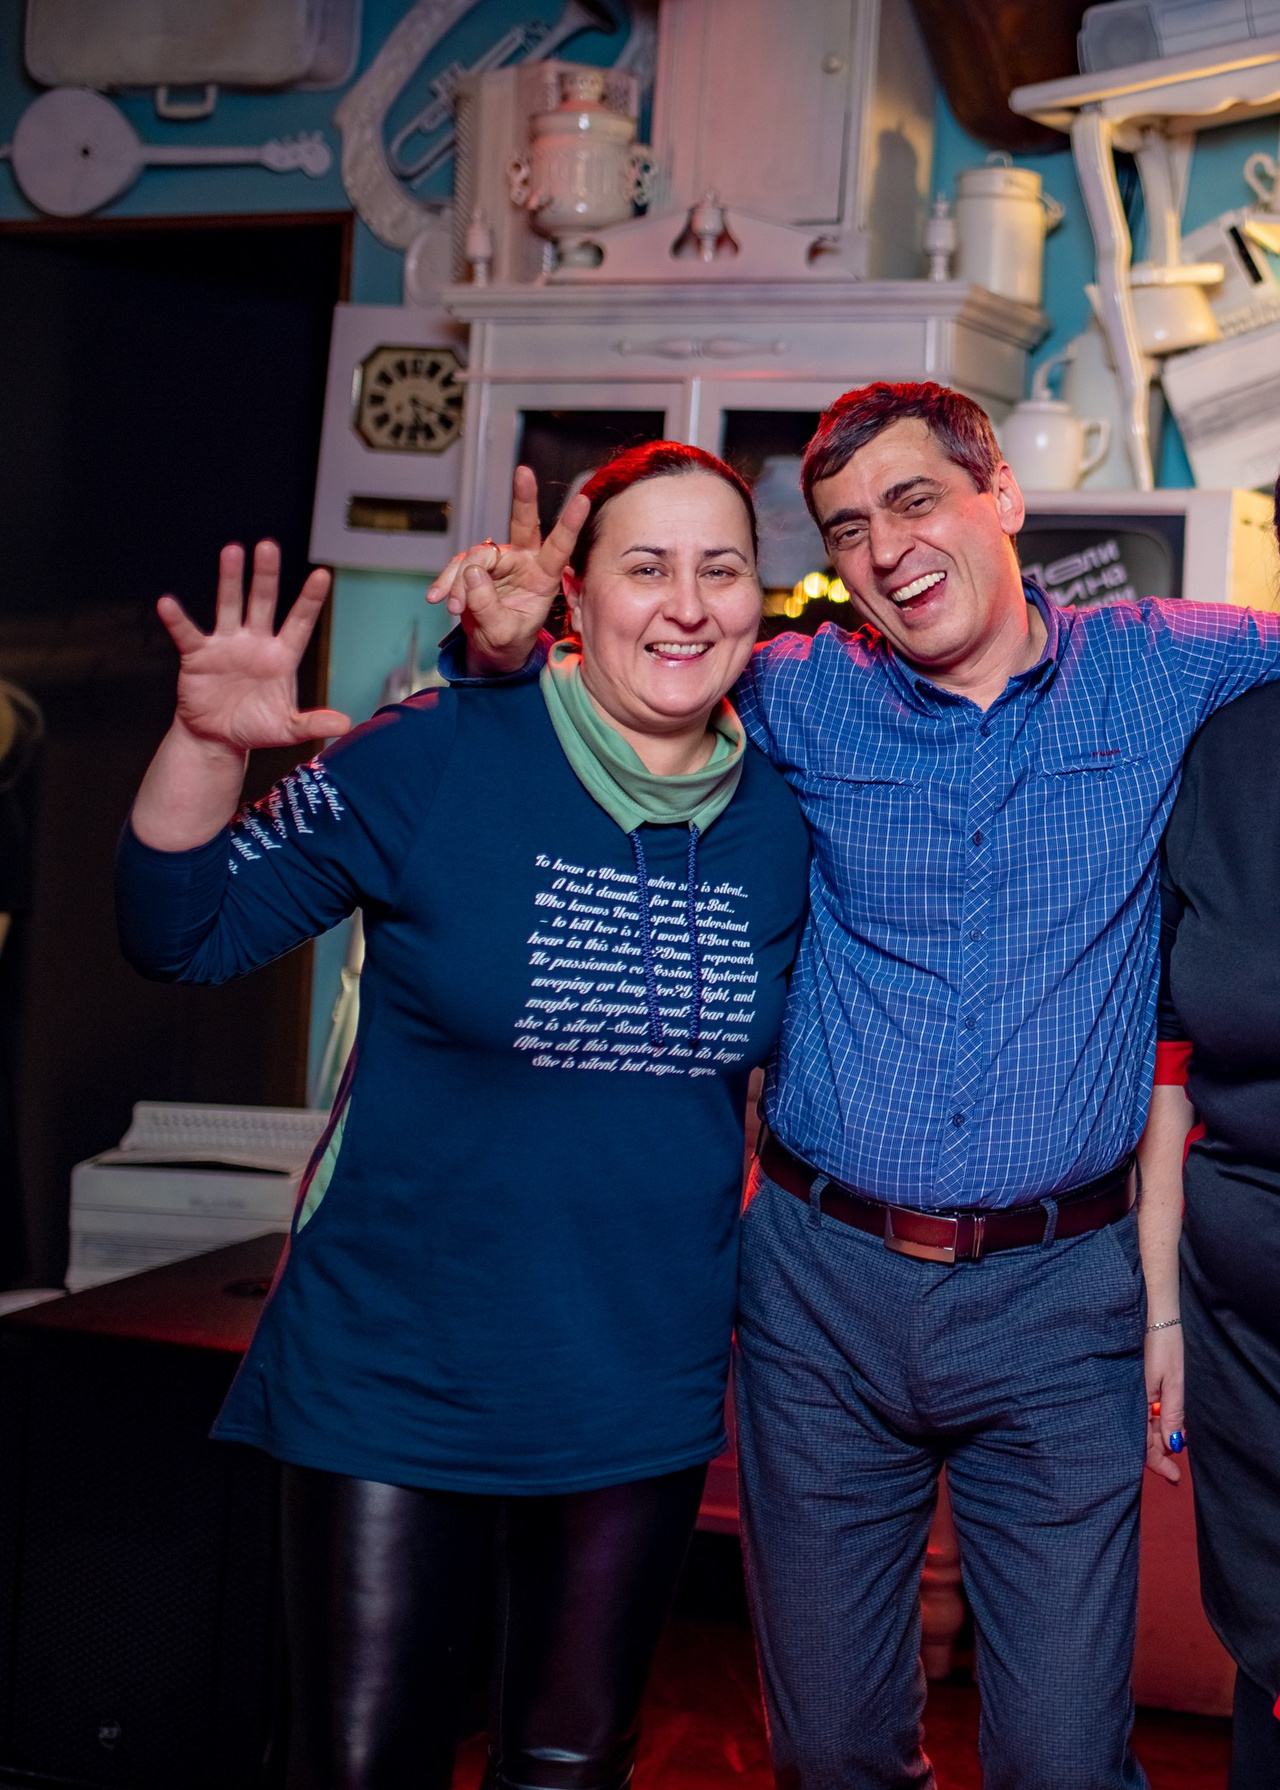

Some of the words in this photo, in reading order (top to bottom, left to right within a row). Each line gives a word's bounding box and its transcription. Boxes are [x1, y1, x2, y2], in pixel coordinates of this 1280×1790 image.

[535, 853, 550, 868] To
[552, 858, 585, 875] hear
[587, 869, 598, 878] a
[598, 867, 639, 885] Woma
[647, 876, 676, 891] when
[700, 881, 711, 893] is
[713, 882, 749, 899] silent...
[551, 877, 567, 890] A
[565, 880, 595, 896] task
[648, 894, 670, 908] for
[534, 892, 566, 909] Who
[567, 898, 610, 916] knows
[694, 915, 750, 933] nderstand
[551, 916, 567, 928] to
[568, 917, 595, 931] kill
[593, 920, 618, 935] her
[620, 925, 632, 937] is
[732, 939, 751, 948] can
[526, 930, 565, 947] hear
[566, 936, 583, 949] in
[584, 938, 609, 952] this
[702, 952, 754, 967] reproach
[547, 957, 628, 973] passionate
[530, 976, 596, 995] weeping
[596, 982, 616, 993] or
[733, 989, 757, 1003] and
[524, 996, 580, 1014] maybe
[726, 1008, 757, 1023] what
[514, 1015, 544, 1030] she
[544, 1017, 560, 1031] is
[562, 1018, 607, 1033] silent
[698, 1029, 724, 1041] not
[512, 1034, 554, 1051] After
[554, 1038, 582, 1053] all,
[582, 1038, 609, 1052] this
[609, 1042, 669, 1058] mystery
[667, 1043, 694, 1058] has
[694, 1046, 712, 1059] its
[531, 1054, 561, 1068] She
[561, 1056, 576, 1069] is
[577, 1057, 620, 1072] silent,
[619, 1058, 648, 1072] but
[644, 1063, 685, 1076] says...
